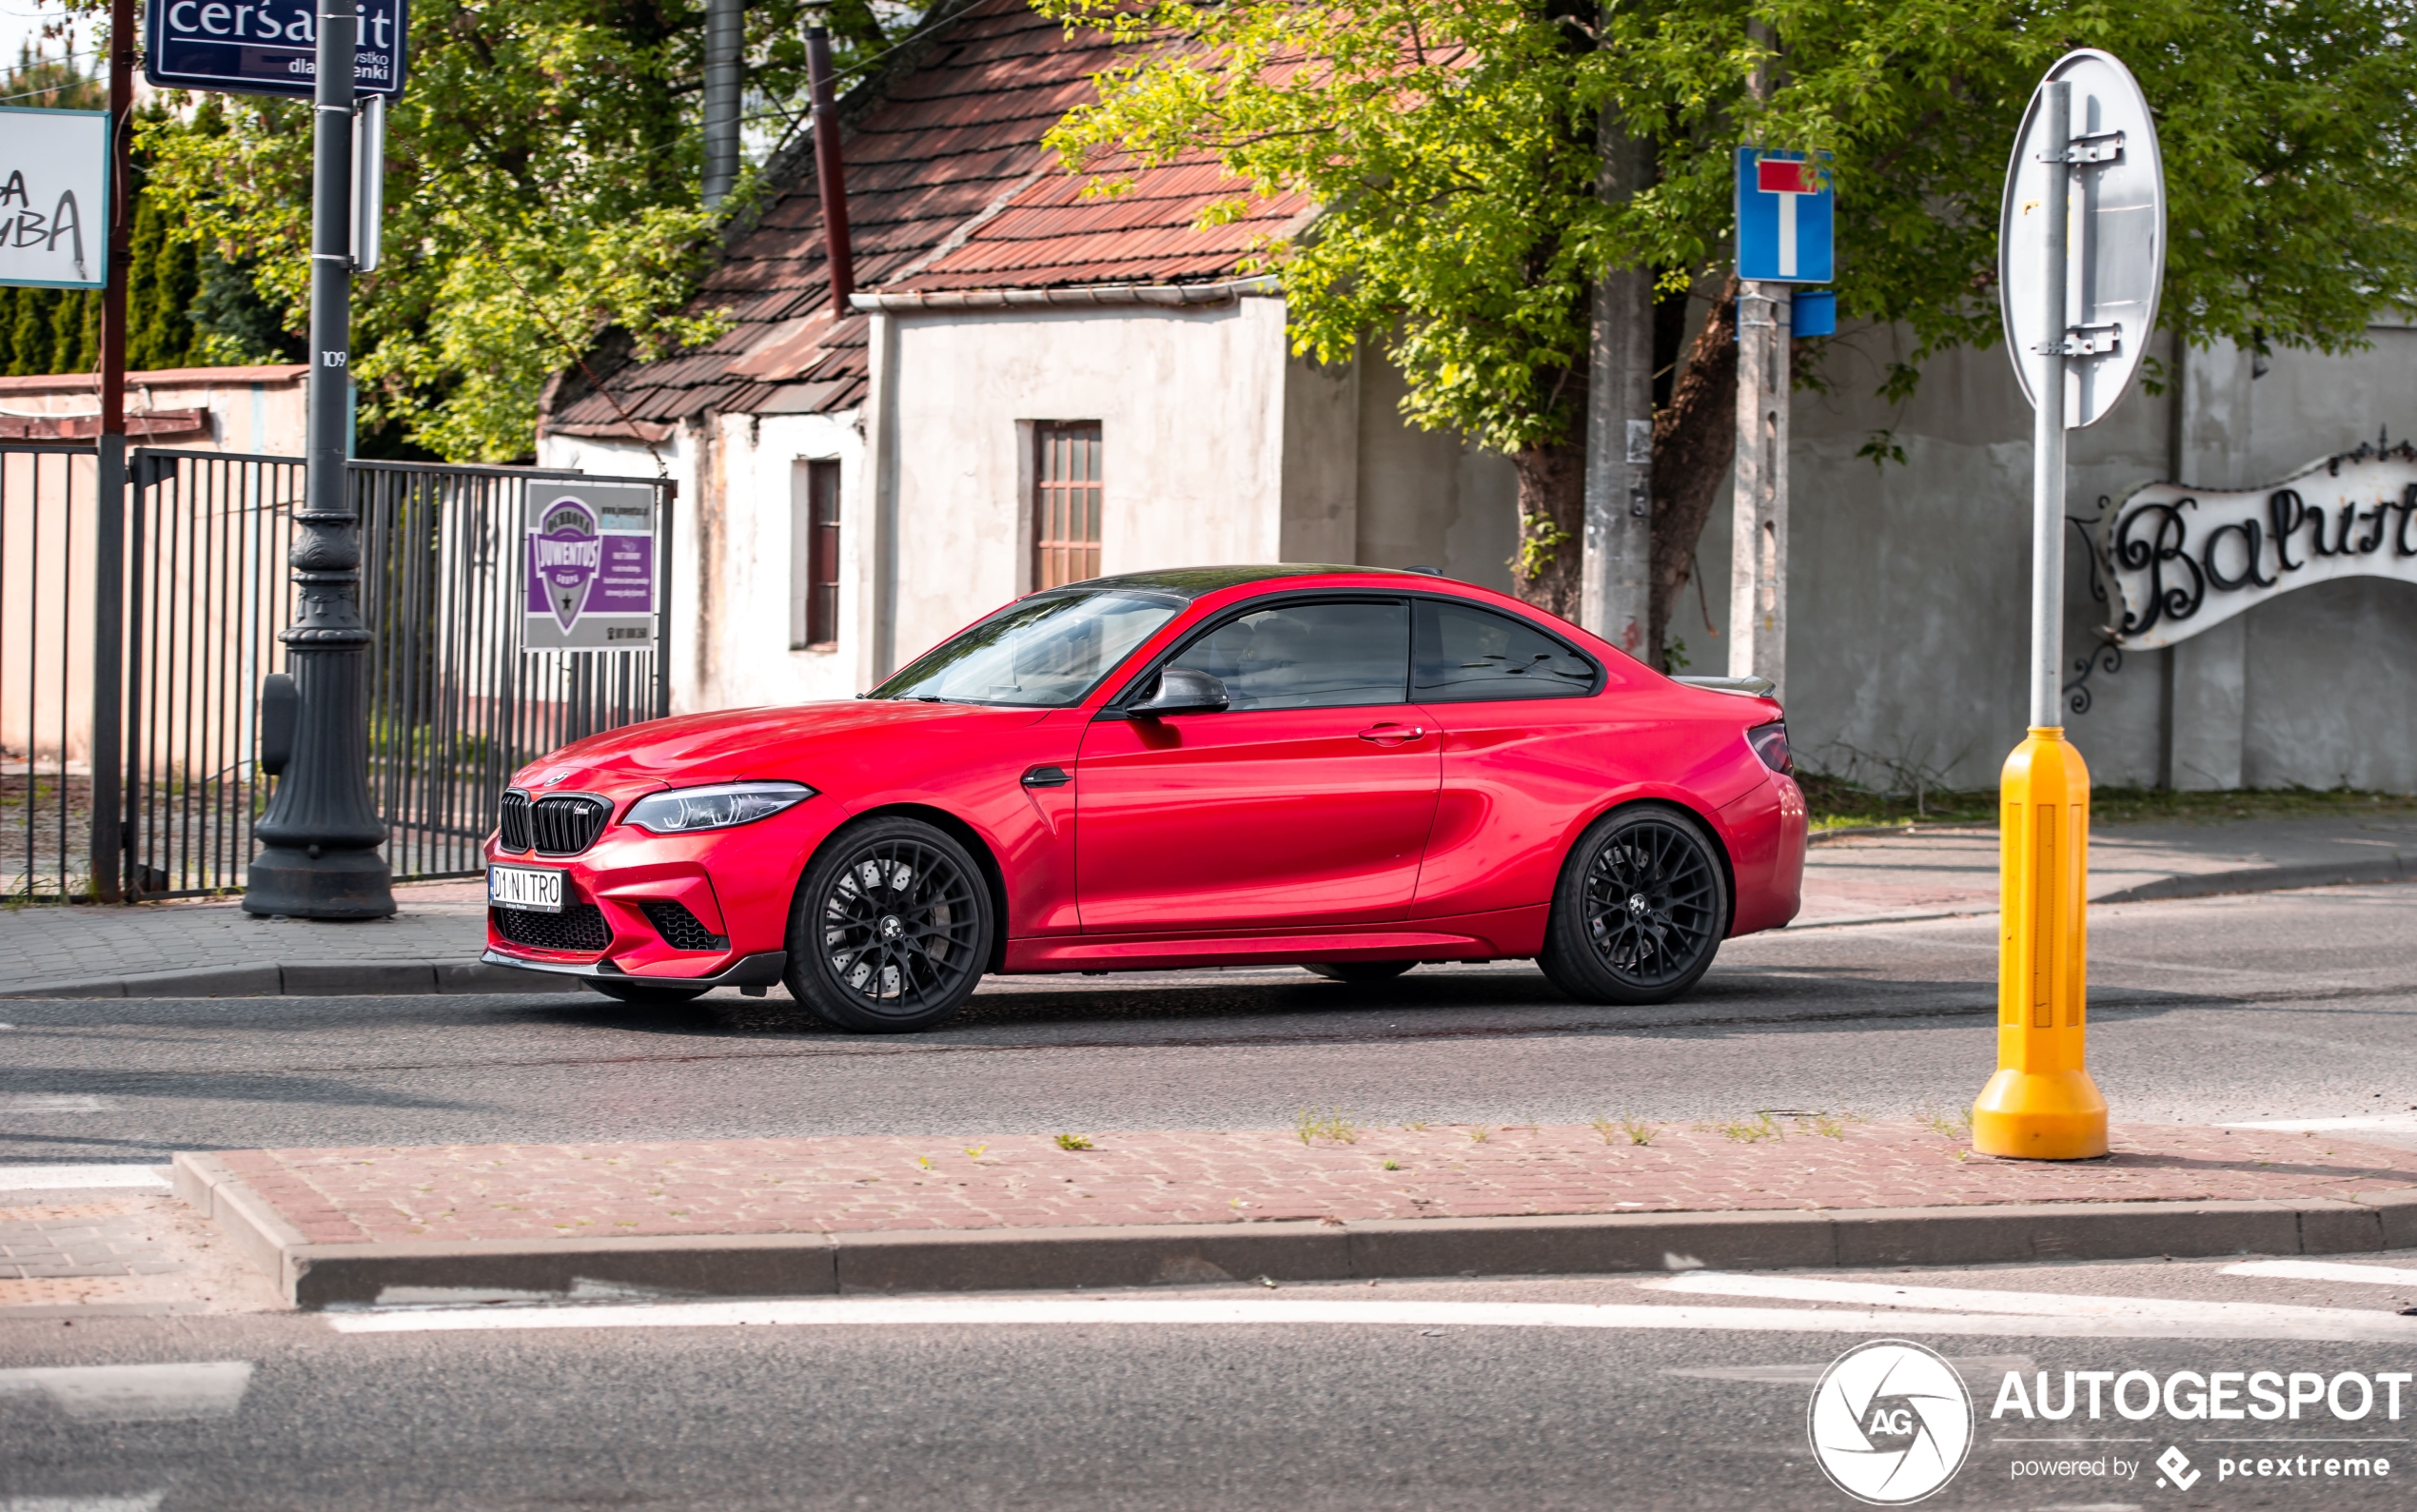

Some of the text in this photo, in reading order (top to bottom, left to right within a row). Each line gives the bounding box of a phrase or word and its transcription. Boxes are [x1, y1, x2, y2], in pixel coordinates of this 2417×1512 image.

[168, 0, 391, 49] cerśait
[288, 58, 388, 80] dla enki
[321, 350, 347, 367] 109
[547, 511, 590, 535] OCHRONA
[539, 539, 599, 568] JUWENTUS
